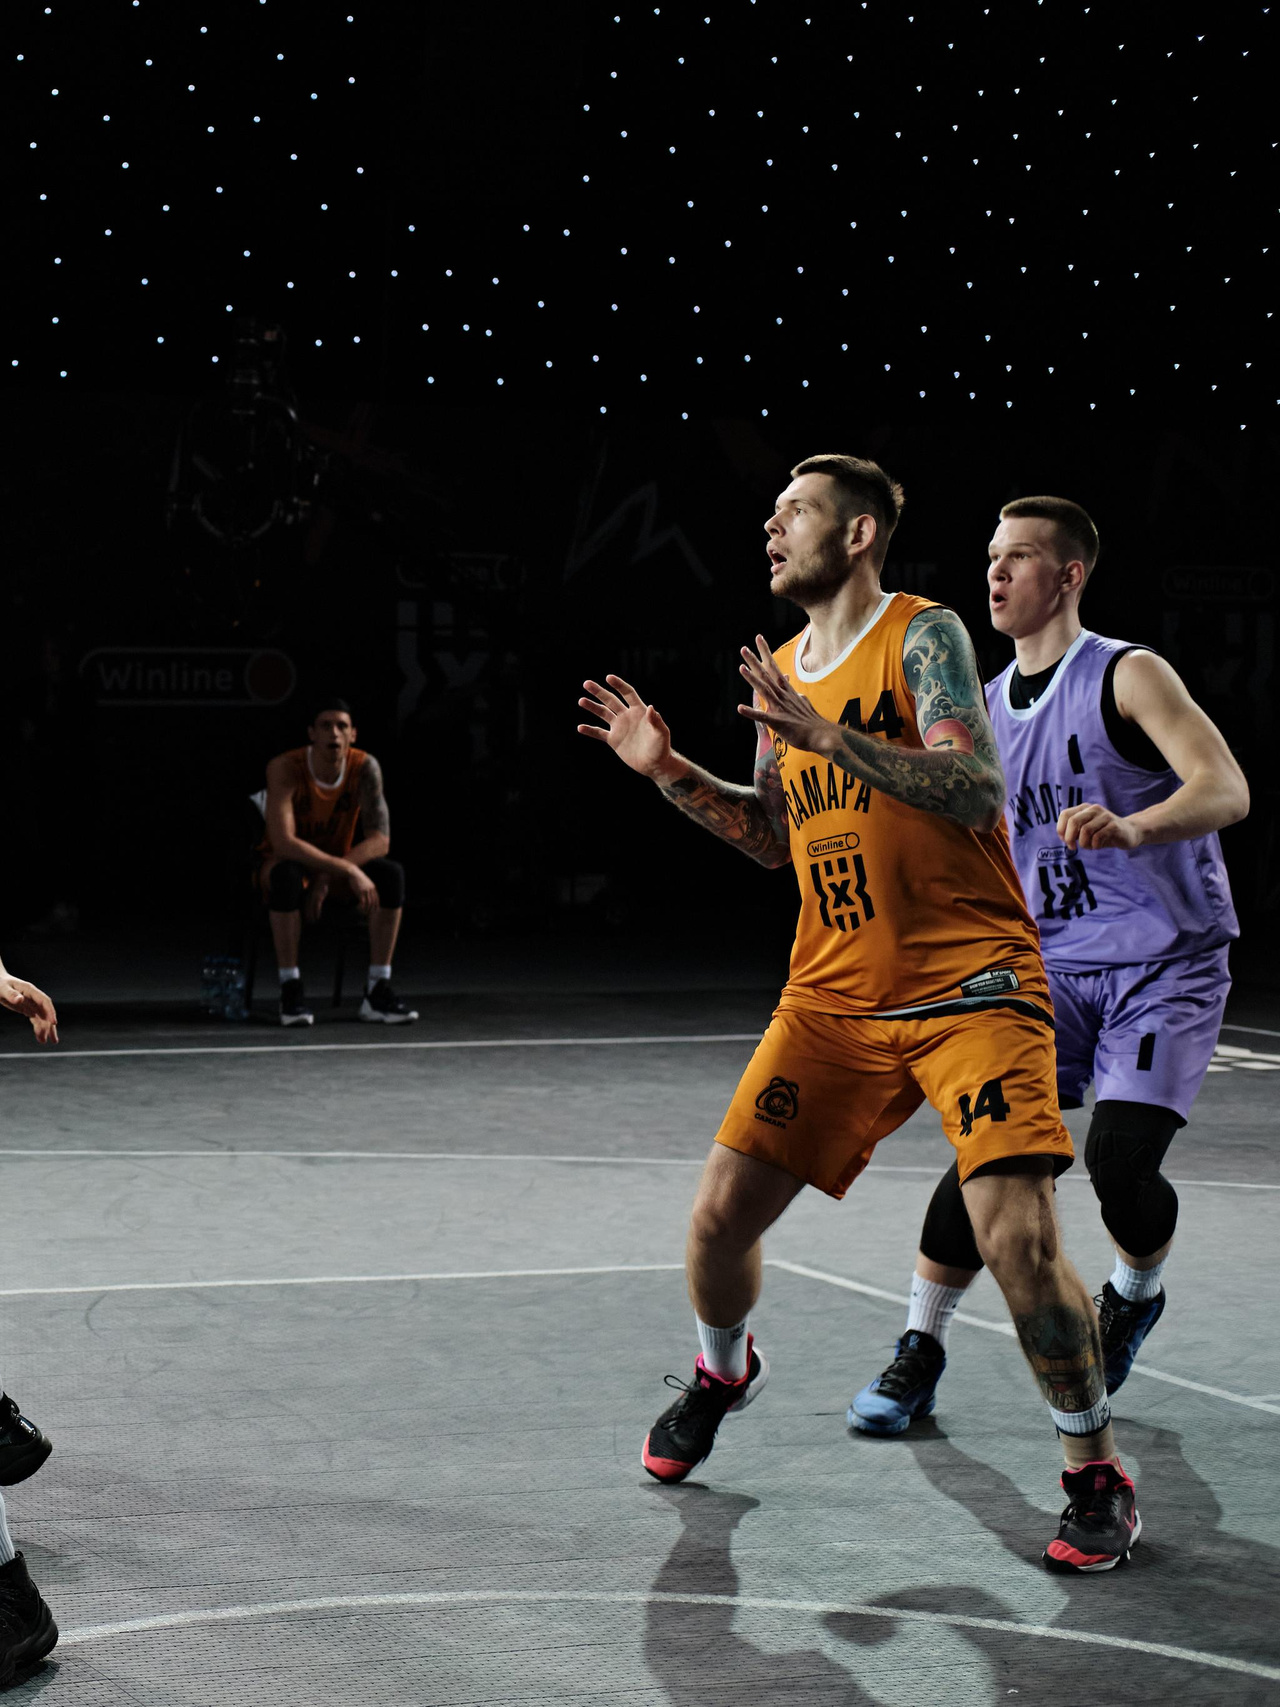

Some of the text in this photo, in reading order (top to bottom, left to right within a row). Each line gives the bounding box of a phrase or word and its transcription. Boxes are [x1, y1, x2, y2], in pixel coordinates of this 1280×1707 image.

[98, 662, 233, 692] Winline
[837, 690, 906, 740] 44
[1067, 734, 1085, 775] 1
[811, 838, 845, 855] Winline
[1136, 1033, 1156, 1071] 1
